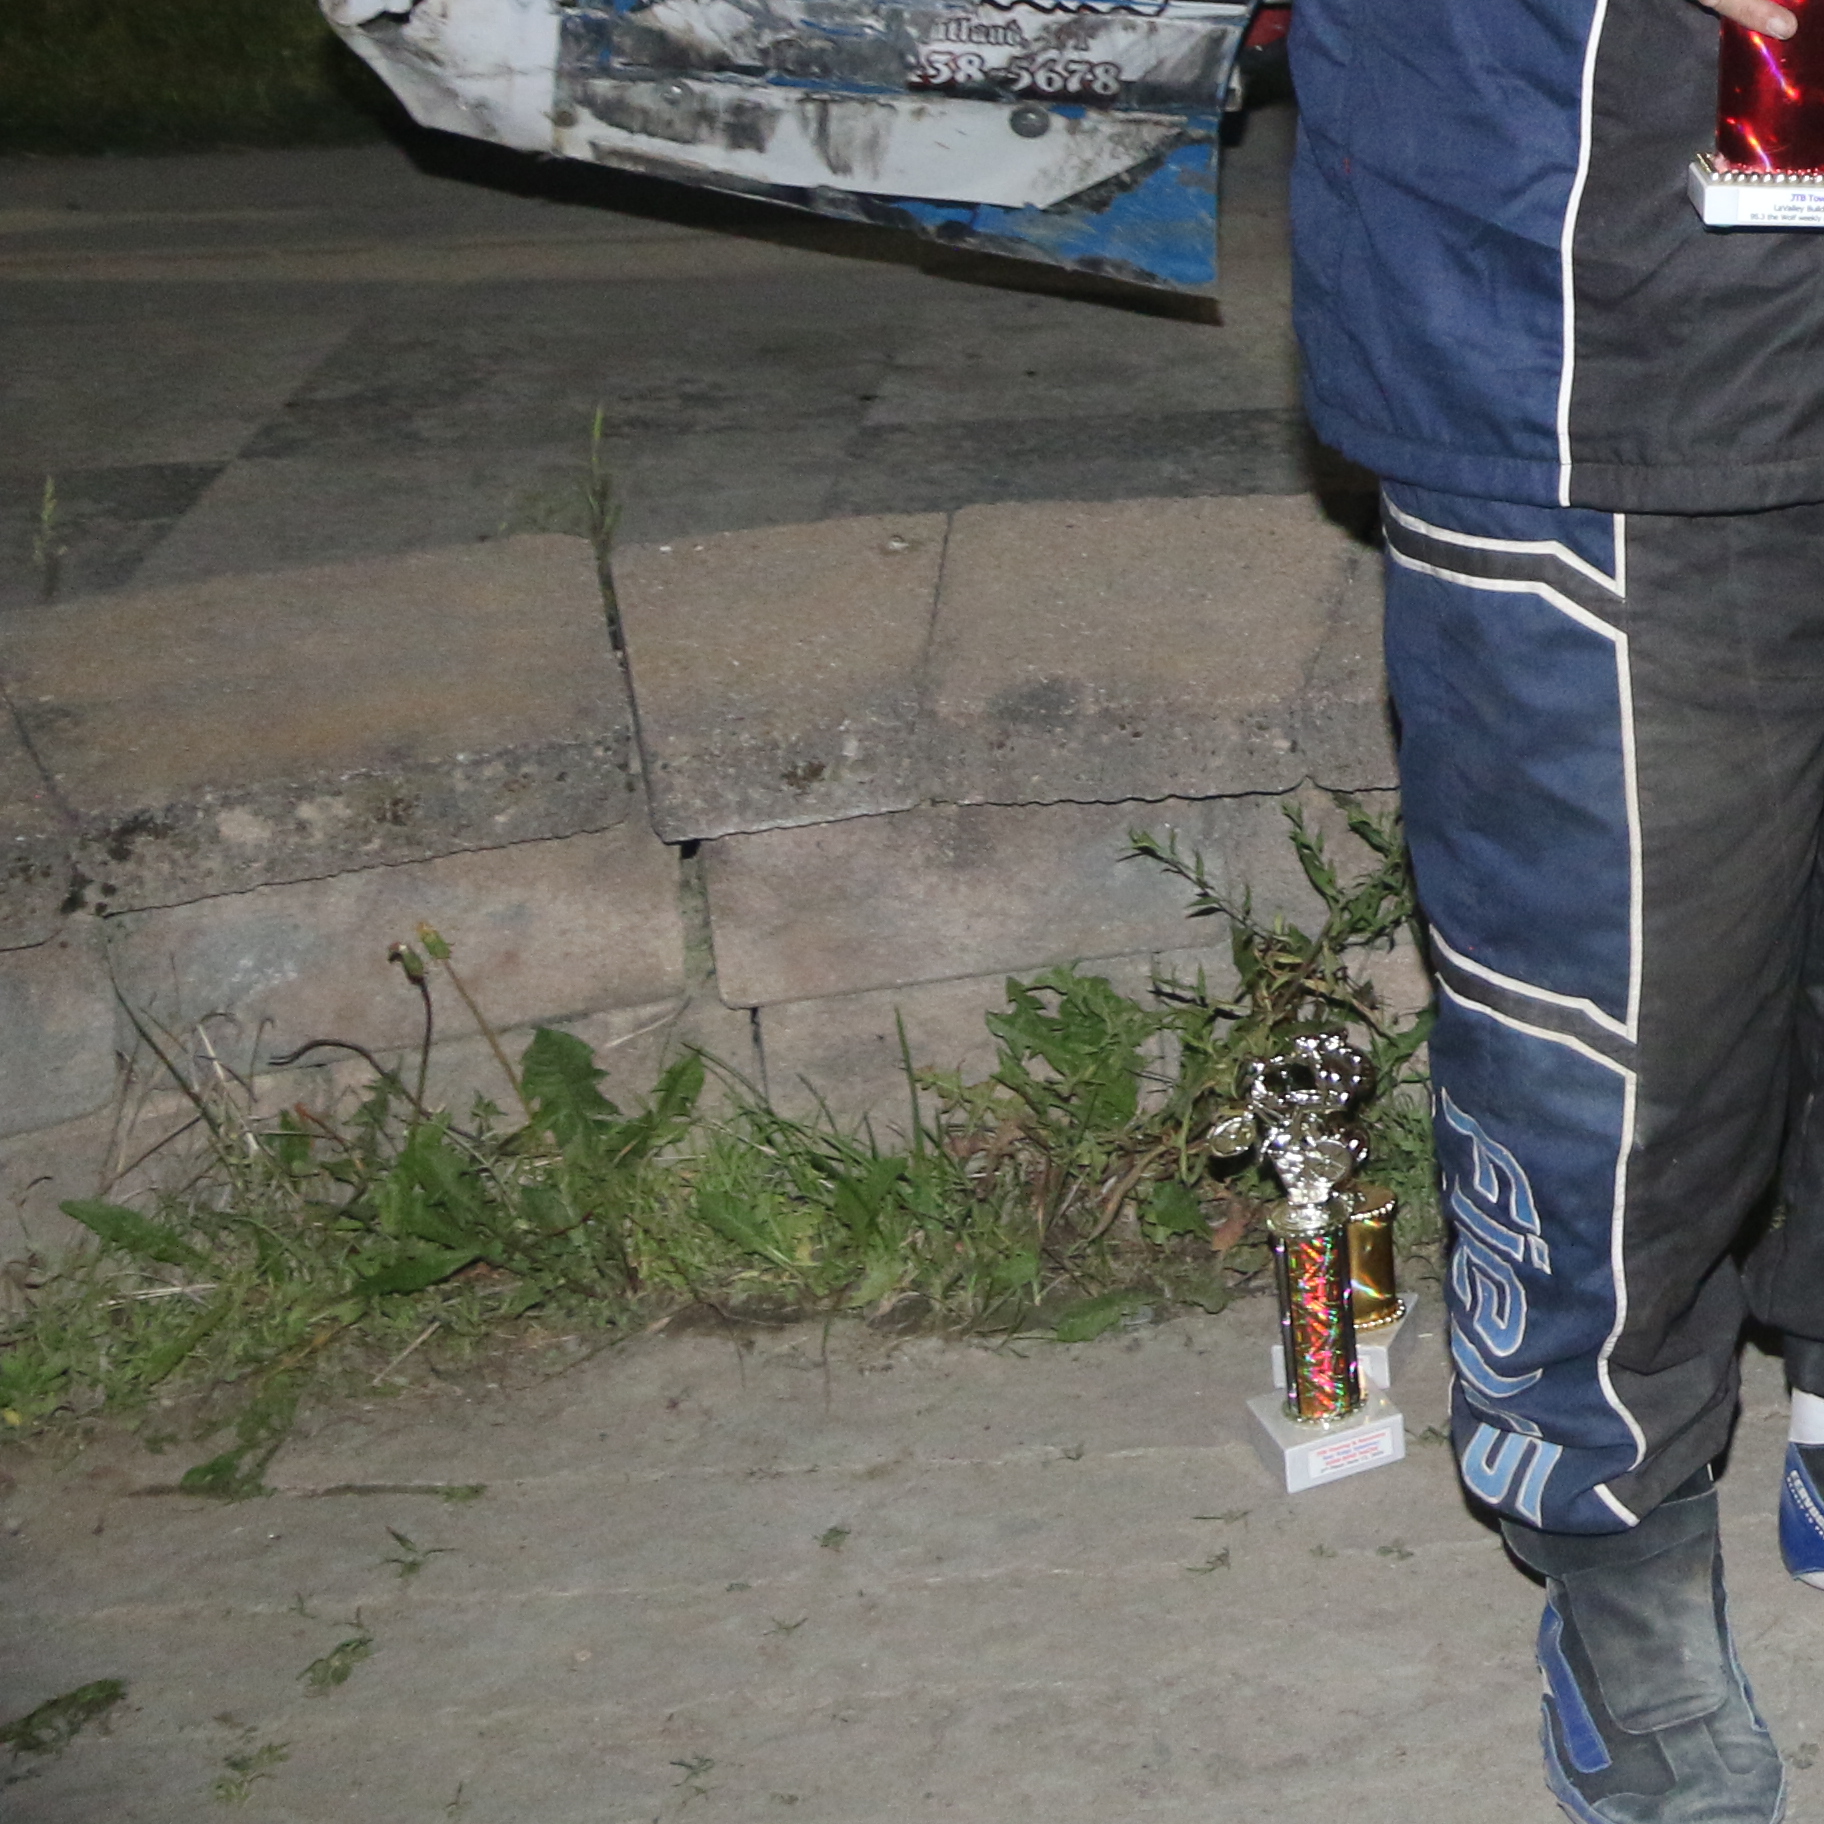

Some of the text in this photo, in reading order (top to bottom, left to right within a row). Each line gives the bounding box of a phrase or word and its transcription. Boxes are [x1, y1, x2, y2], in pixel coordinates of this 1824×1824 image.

[1790, 194, 1806, 203] JTB
[1781, 214, 1796, 222] Wolf
[1799, 214, 1821, 223] weekly
